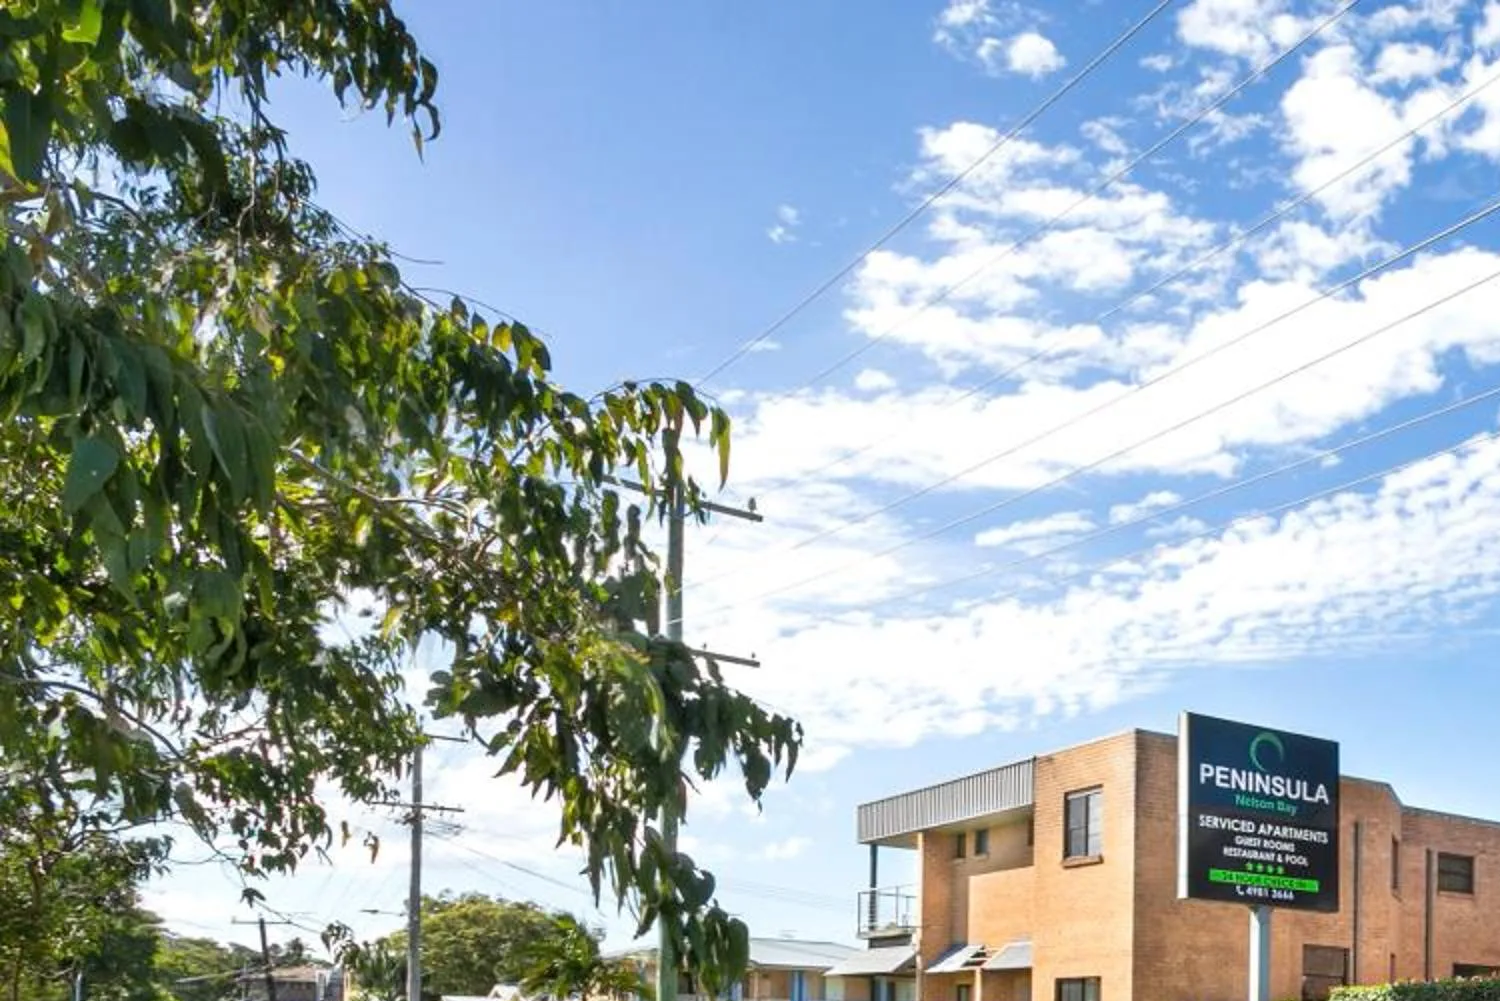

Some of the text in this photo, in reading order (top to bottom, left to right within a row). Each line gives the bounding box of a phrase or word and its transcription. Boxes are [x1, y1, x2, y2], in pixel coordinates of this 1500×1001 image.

[1199, 763, 1330, 804] PENINSULA
[1235, 794, 1297, 816] Nelson Bay
[1199, 815, 1328, 844] SERVICED APARTMENTS
[1223, 847, 1275, 861] RESTAURANT
[1286, 855, 1309, 867] POOL
[1263, 839, 1295, 853] ROOMS
